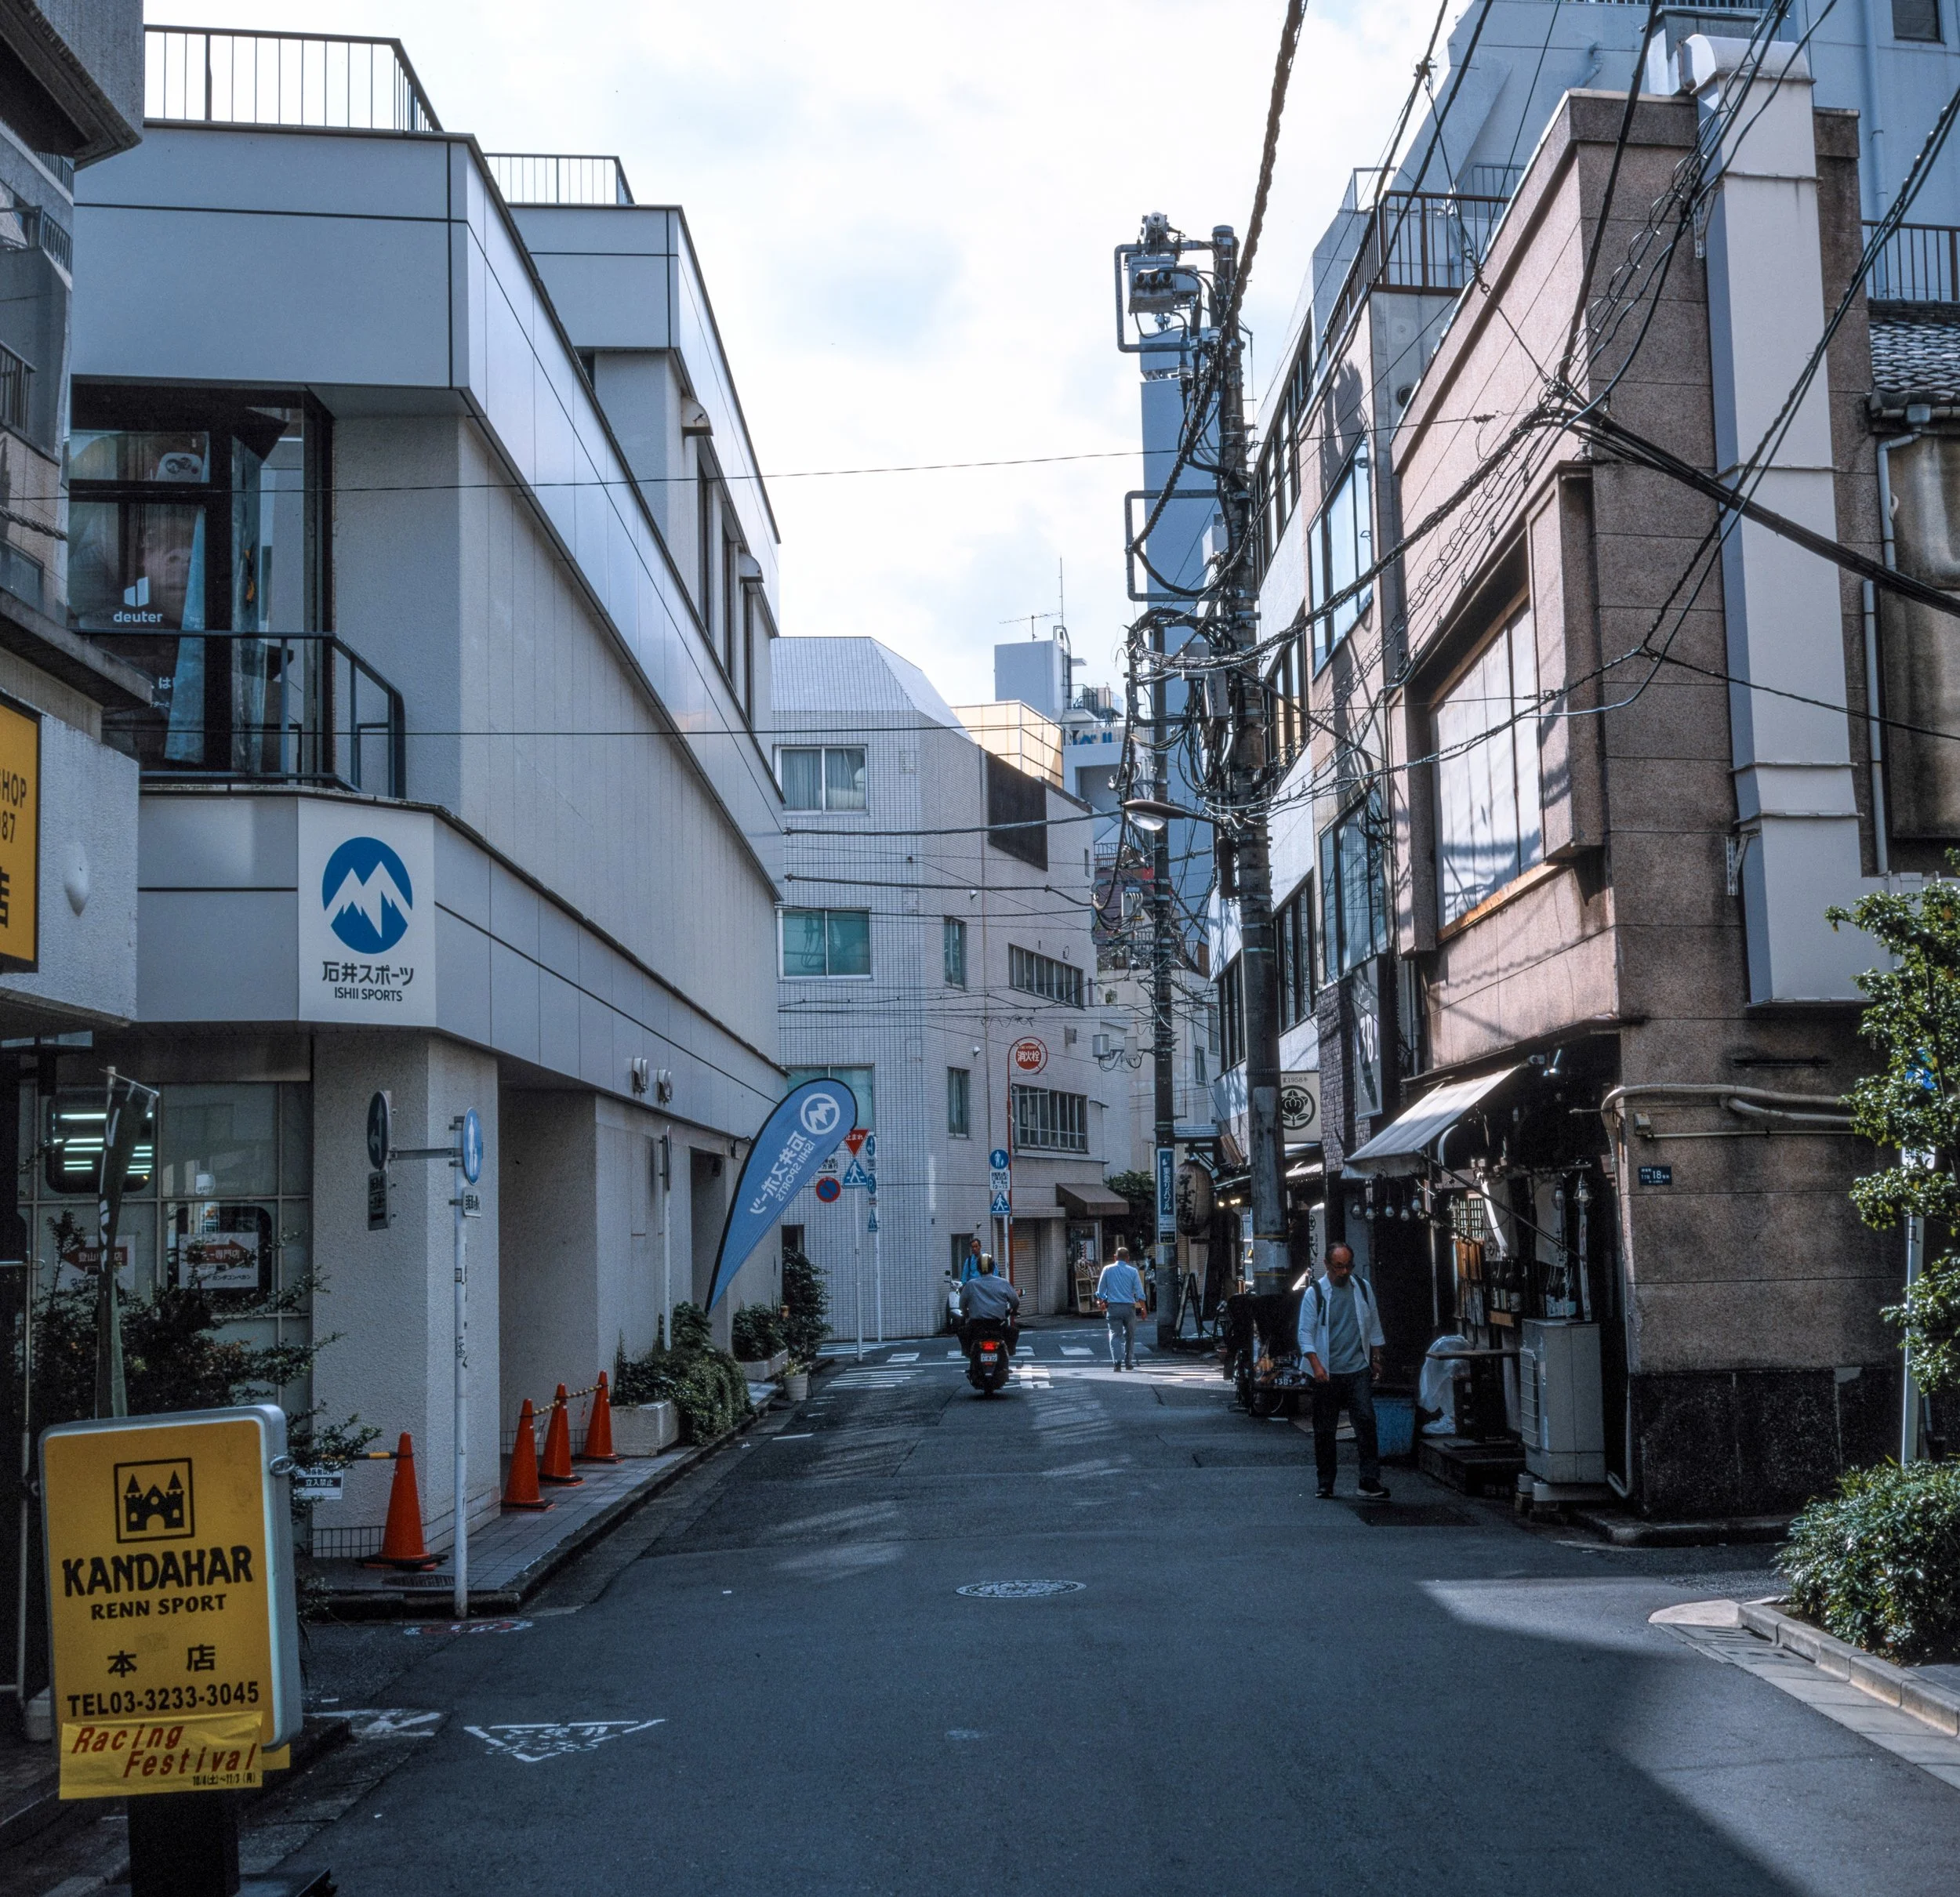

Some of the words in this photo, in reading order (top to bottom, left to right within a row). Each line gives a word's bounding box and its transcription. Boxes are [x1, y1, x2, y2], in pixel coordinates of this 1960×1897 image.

[113, 611, 163, 623] deuter
[0, 767, 27, 808] HOP
[0, 810, 16, 843] 87
[322, 961, 414, 986] 石井スポーツ
[334, 987, 358, 999] ISHII
[361, 988, 403, 1002] SPORTS
[1017, 1050, 1040, 1061] 消火栓
[845, 1133, 863, 1141] 止まれ
[1653, 1170, 1661, 1179] 18
[306, 1478, 334, 1487] 立入禁止
[62, 1545, 253, 1598] KANDAHAR
[90, 1600, 151, 1621] RENN
[158, 1594, 227, 1615] SPORT
[67, 1681, 260, 1717] TEL03-3233-3045
[71, 1724, 184, 1754] Racing
[123, 1743, 257, 1779] Festival
